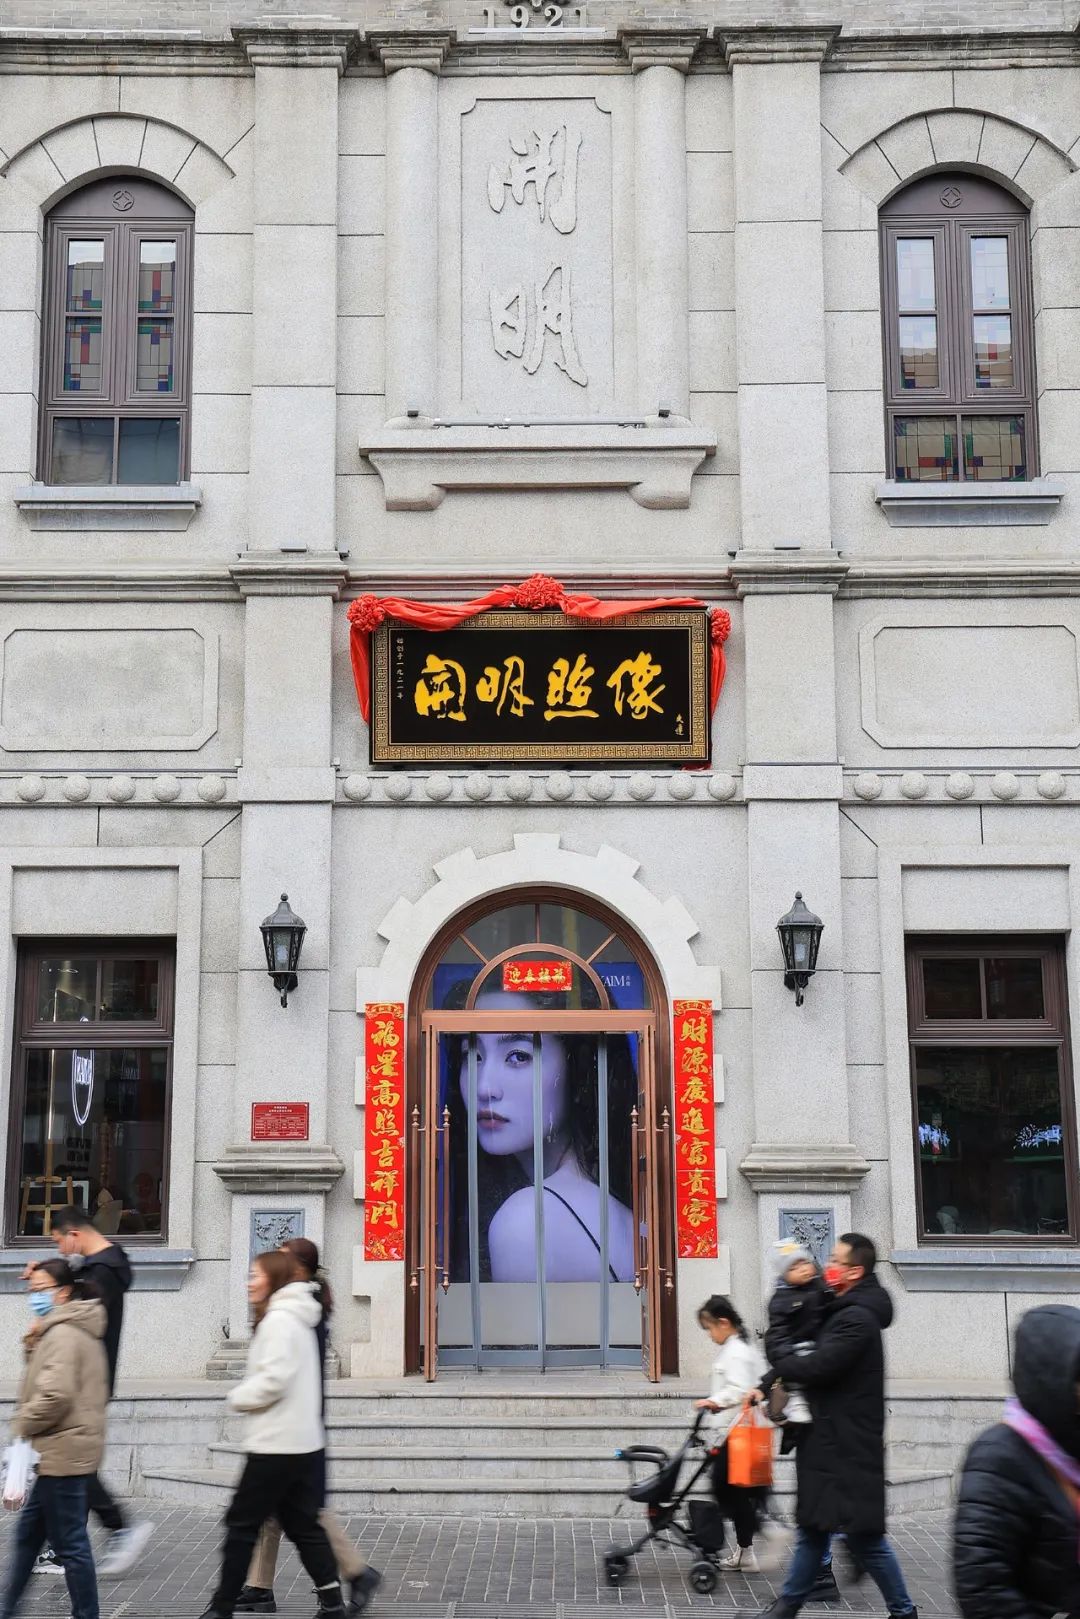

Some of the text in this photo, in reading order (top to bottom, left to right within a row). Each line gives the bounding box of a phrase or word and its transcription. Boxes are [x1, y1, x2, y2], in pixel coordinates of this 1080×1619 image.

[483, 5, 587, 28] 1921
[509, 967, 566, 984] 迎春接福
[371, 1020, 400, 1228] 福星高照吉祥門
